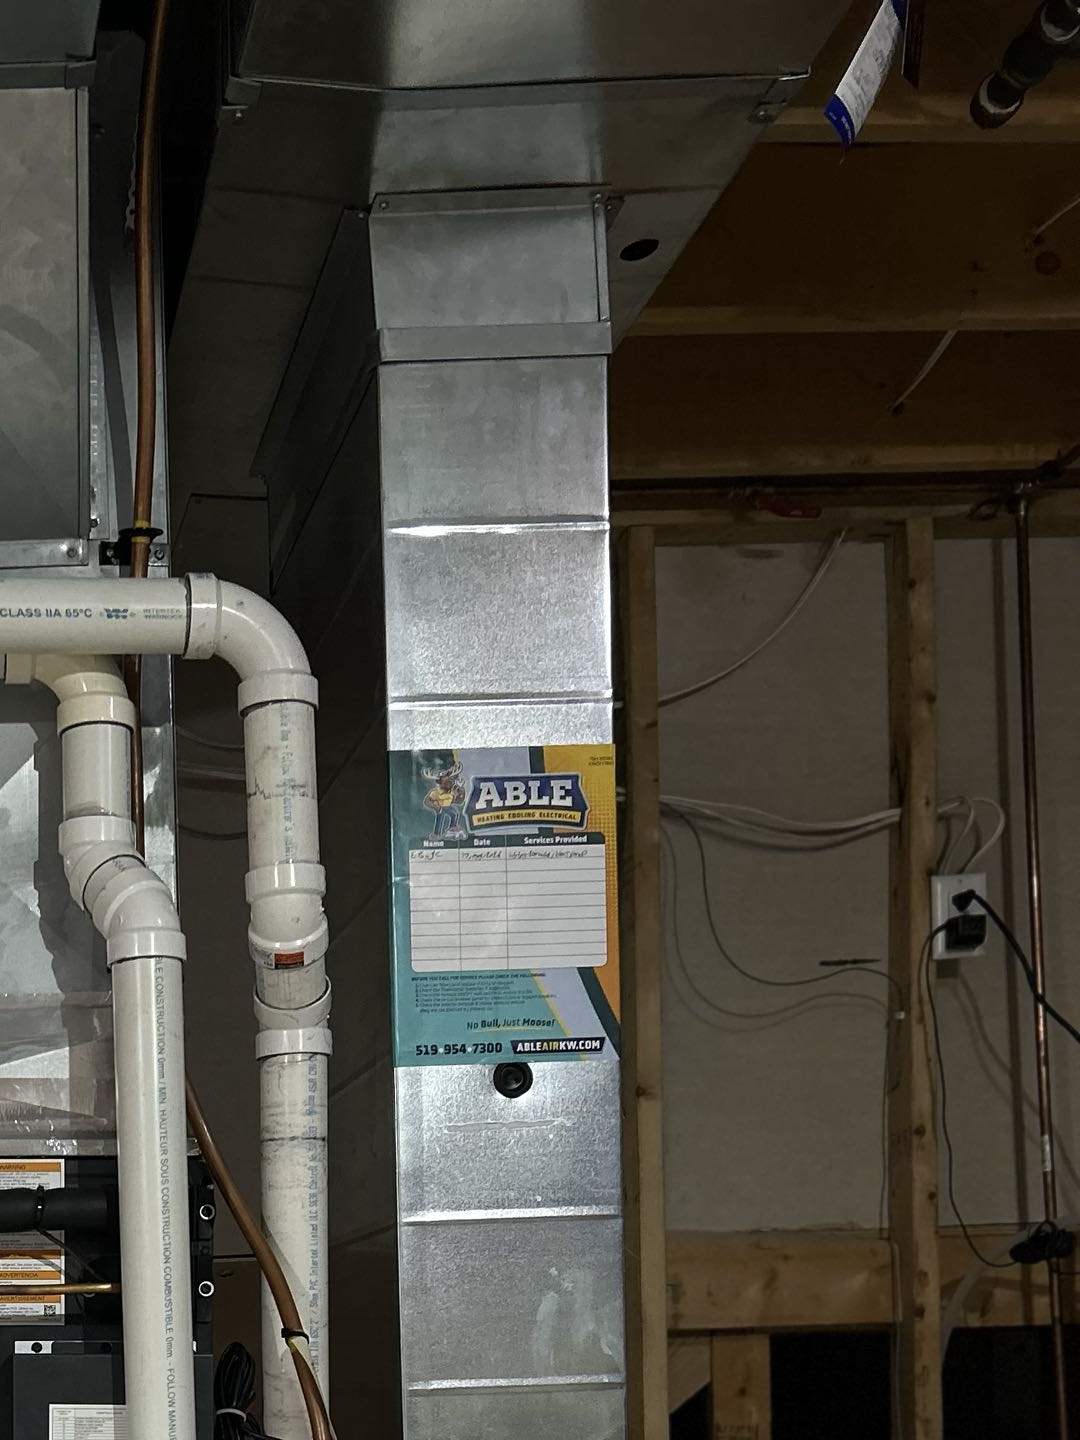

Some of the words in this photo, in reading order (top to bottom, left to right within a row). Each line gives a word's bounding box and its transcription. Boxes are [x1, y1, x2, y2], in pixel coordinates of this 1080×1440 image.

[0, 607, 42, 619] CLASS
[45, 608, 62, 619] IIA
[476, 779, 573, 809] ABLE
[477, 813, 505, 823] HEATING
[539, 812, 577, 821] ELECTRICAL
[473, 838, 491, 846] Date
[524, 836, 554, 845] Services
[555, 835, 588, 844] Provided
[155, 976, 166, 1054] CONSTRUCTION
[466, 1021, 479, 1030] No
[502, 1018, 521, 1027] Just
[522, 1018, 556, 1027] Moose!
[516, 1040, 601, 1052] ABLEAIRKW.COM
[159, 1109, 169, 1155] HAUTEUR
[160, 1158, 169, 1185] SOUS
[161, 1187, 171, 1264] CONSTRUCTION
[163, 1266, 174, 1334] COMBUSTIBLE
[167, 1368, 177, 1408] FOLLOW
